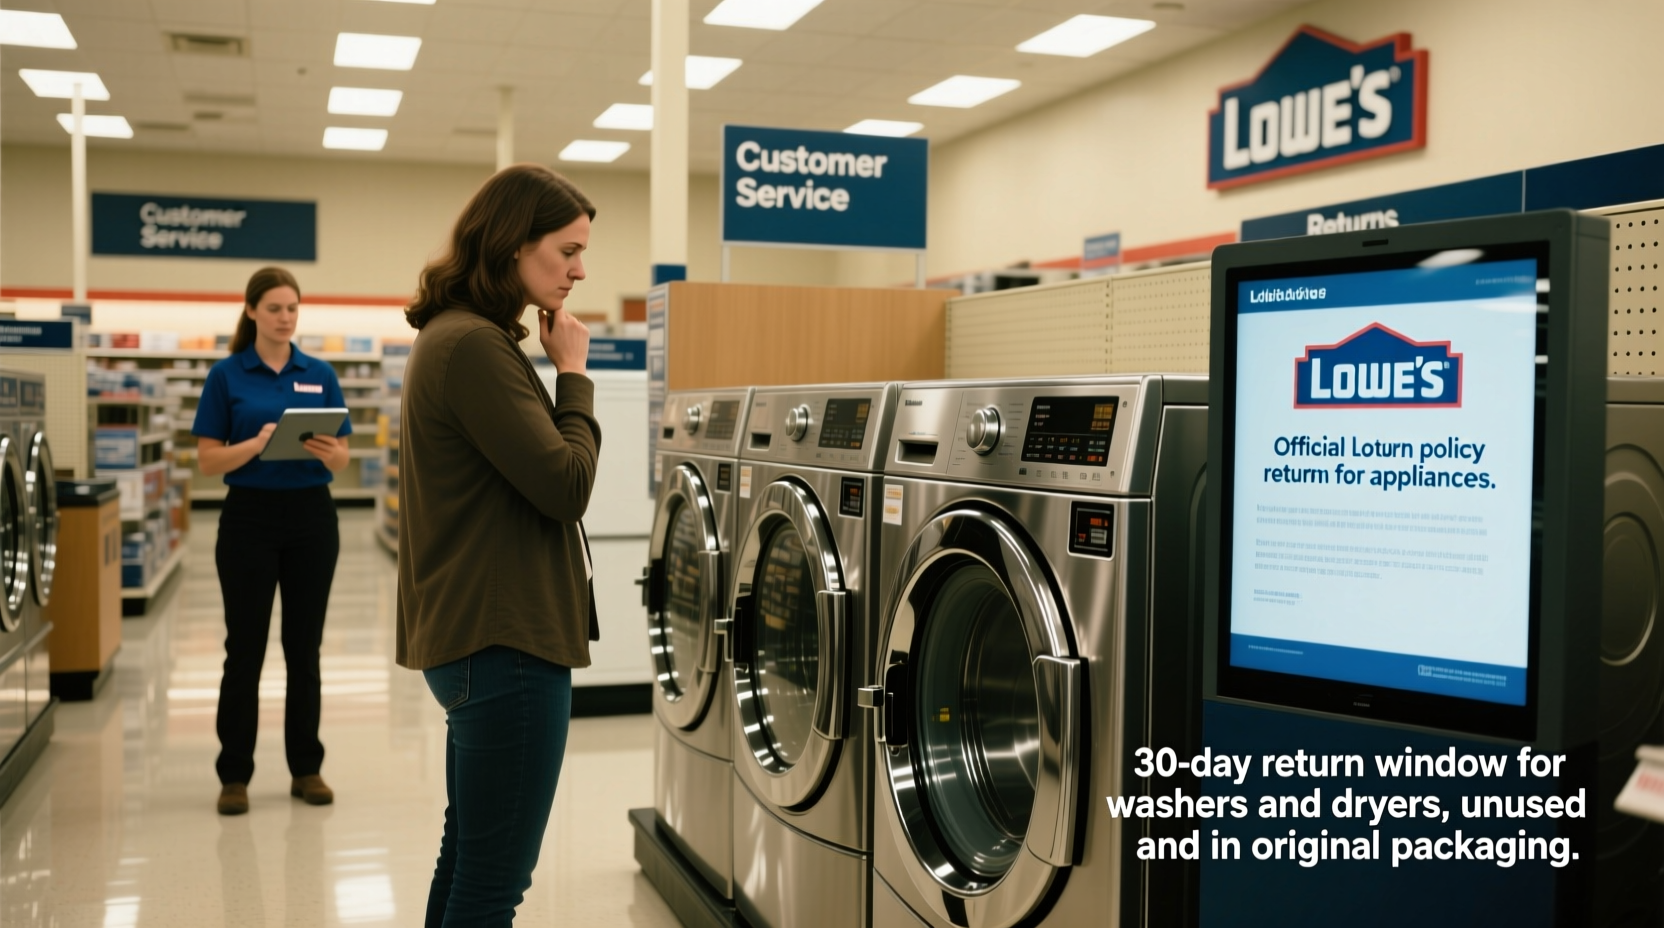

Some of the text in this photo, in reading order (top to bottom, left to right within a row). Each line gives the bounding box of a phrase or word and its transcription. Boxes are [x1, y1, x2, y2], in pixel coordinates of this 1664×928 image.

[736, 140, 888, 178] Customer
[736, 177, 850, 211] Service
[139, 202, 247, 228] Customer
[1307, 209, 1399, 236] Returns
[139, 225, 224, 250] Service
[1274, 435, 1345, 457] Official
[1420, 436, 1486, 465] policy
[1334, 463, 1366, 485] for
[1369, 464, 1496, 492] appliances.
